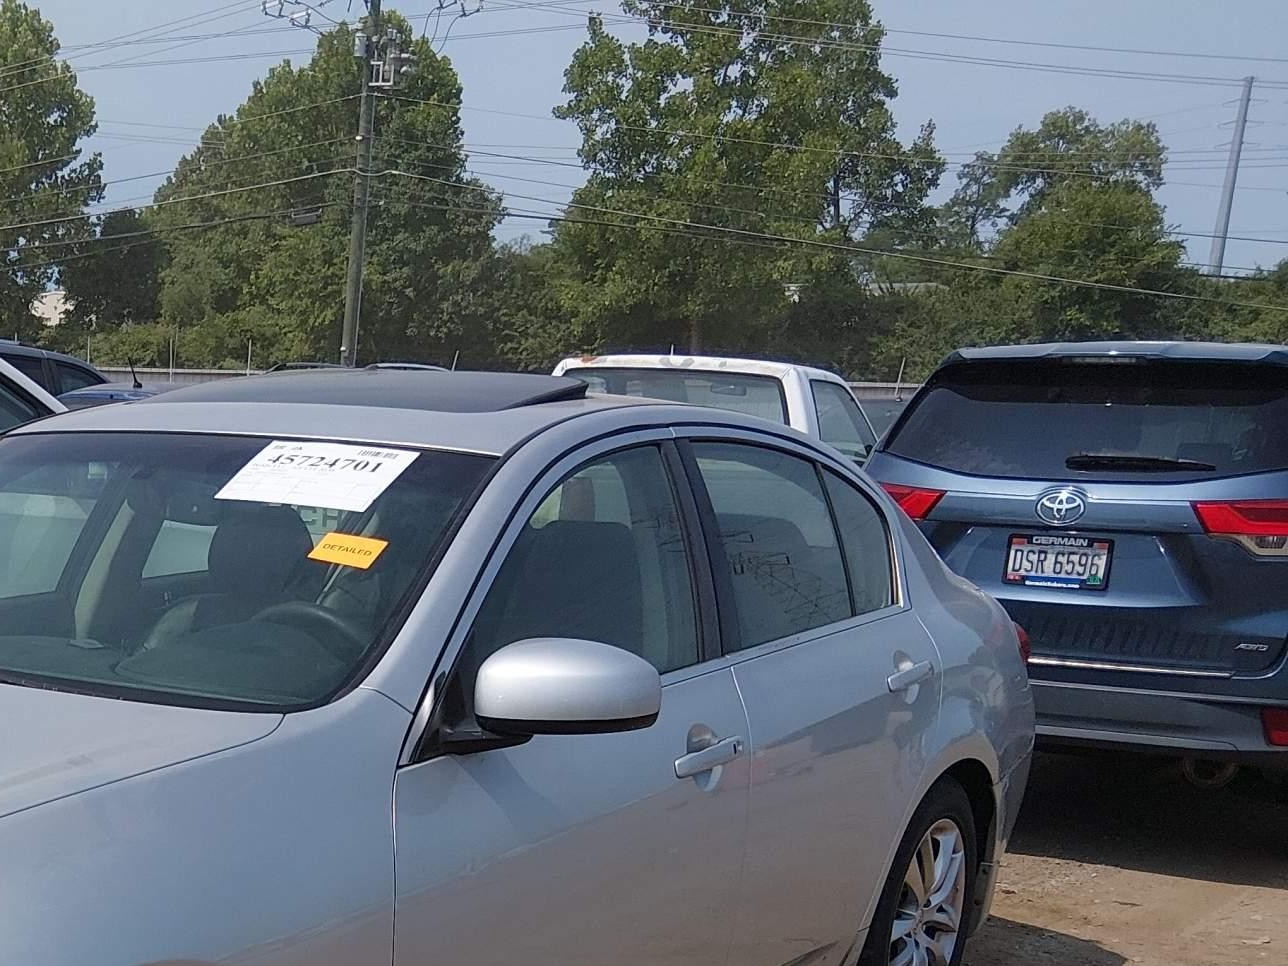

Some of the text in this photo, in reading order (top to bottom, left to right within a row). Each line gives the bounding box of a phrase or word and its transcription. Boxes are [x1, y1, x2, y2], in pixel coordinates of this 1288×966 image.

[267, 454, 383, 473] 45724701
[1032, 536, 1088, 546] GERMAIN
[322, 543, 372, 557] DETAILED
[1013, 549, 1100, 576] DSR 6596
